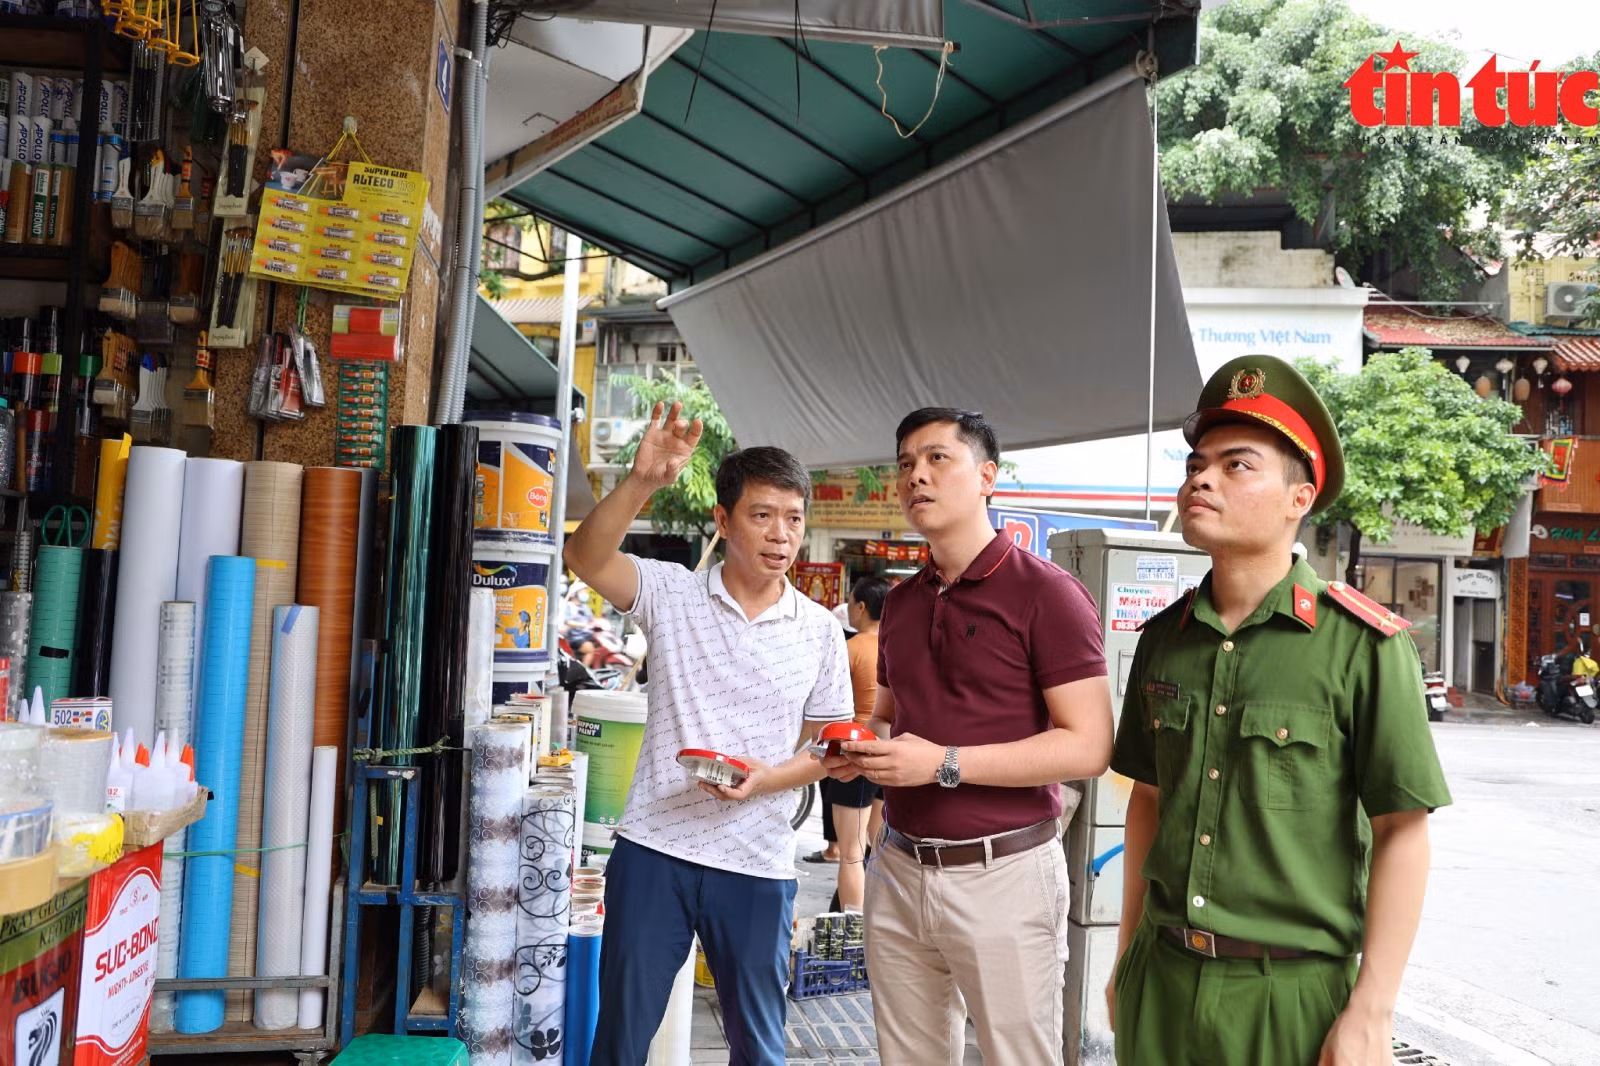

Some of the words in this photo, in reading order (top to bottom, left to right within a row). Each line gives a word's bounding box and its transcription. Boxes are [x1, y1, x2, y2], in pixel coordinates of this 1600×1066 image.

[18, 121, 28, 160] APOLLO
[34, 122, 43, 160] APOLLO
[364, 166, 390, 177] SUPER
[353, 174, 394, 189] ALTECO
[32, 202, 44, 235] HI-BOND
[1260, 328, 1292, 346] Việt
[1294, 329, 1332, 344] Nam
[473, 574, 511, 587] Dulux
[54, 709, 72, 726] 502
